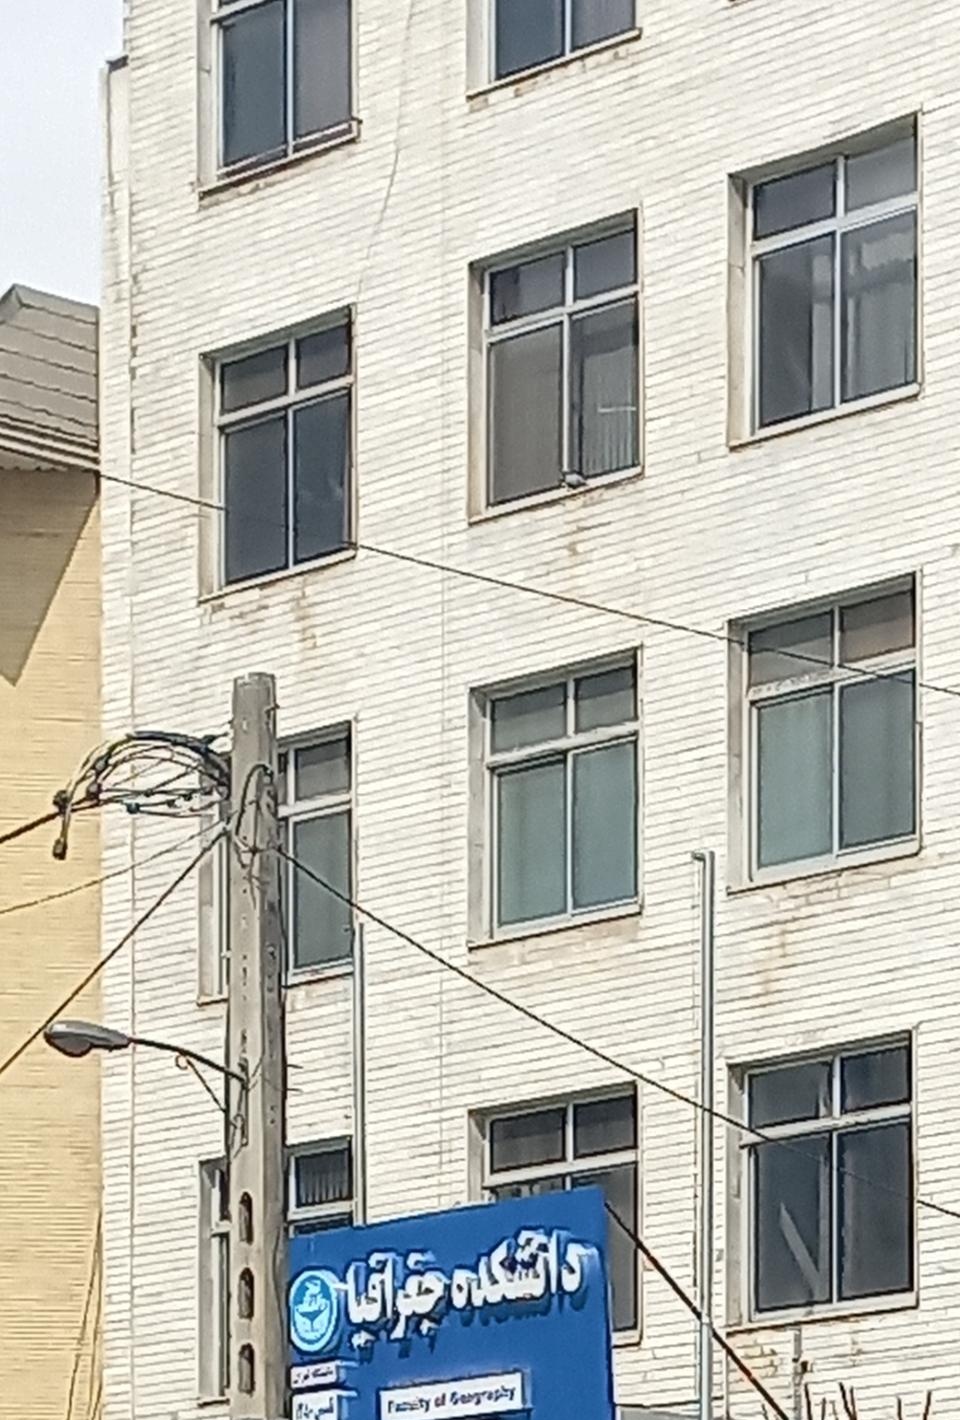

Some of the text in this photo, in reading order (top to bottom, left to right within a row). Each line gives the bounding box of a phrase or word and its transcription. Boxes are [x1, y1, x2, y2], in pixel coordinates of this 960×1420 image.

[345, 1251, 446, 1348] جغرافیا
[451, 1229, 590, 1309] دانشکده
[387, 1385, 516, 1414] Faculty of Geography
